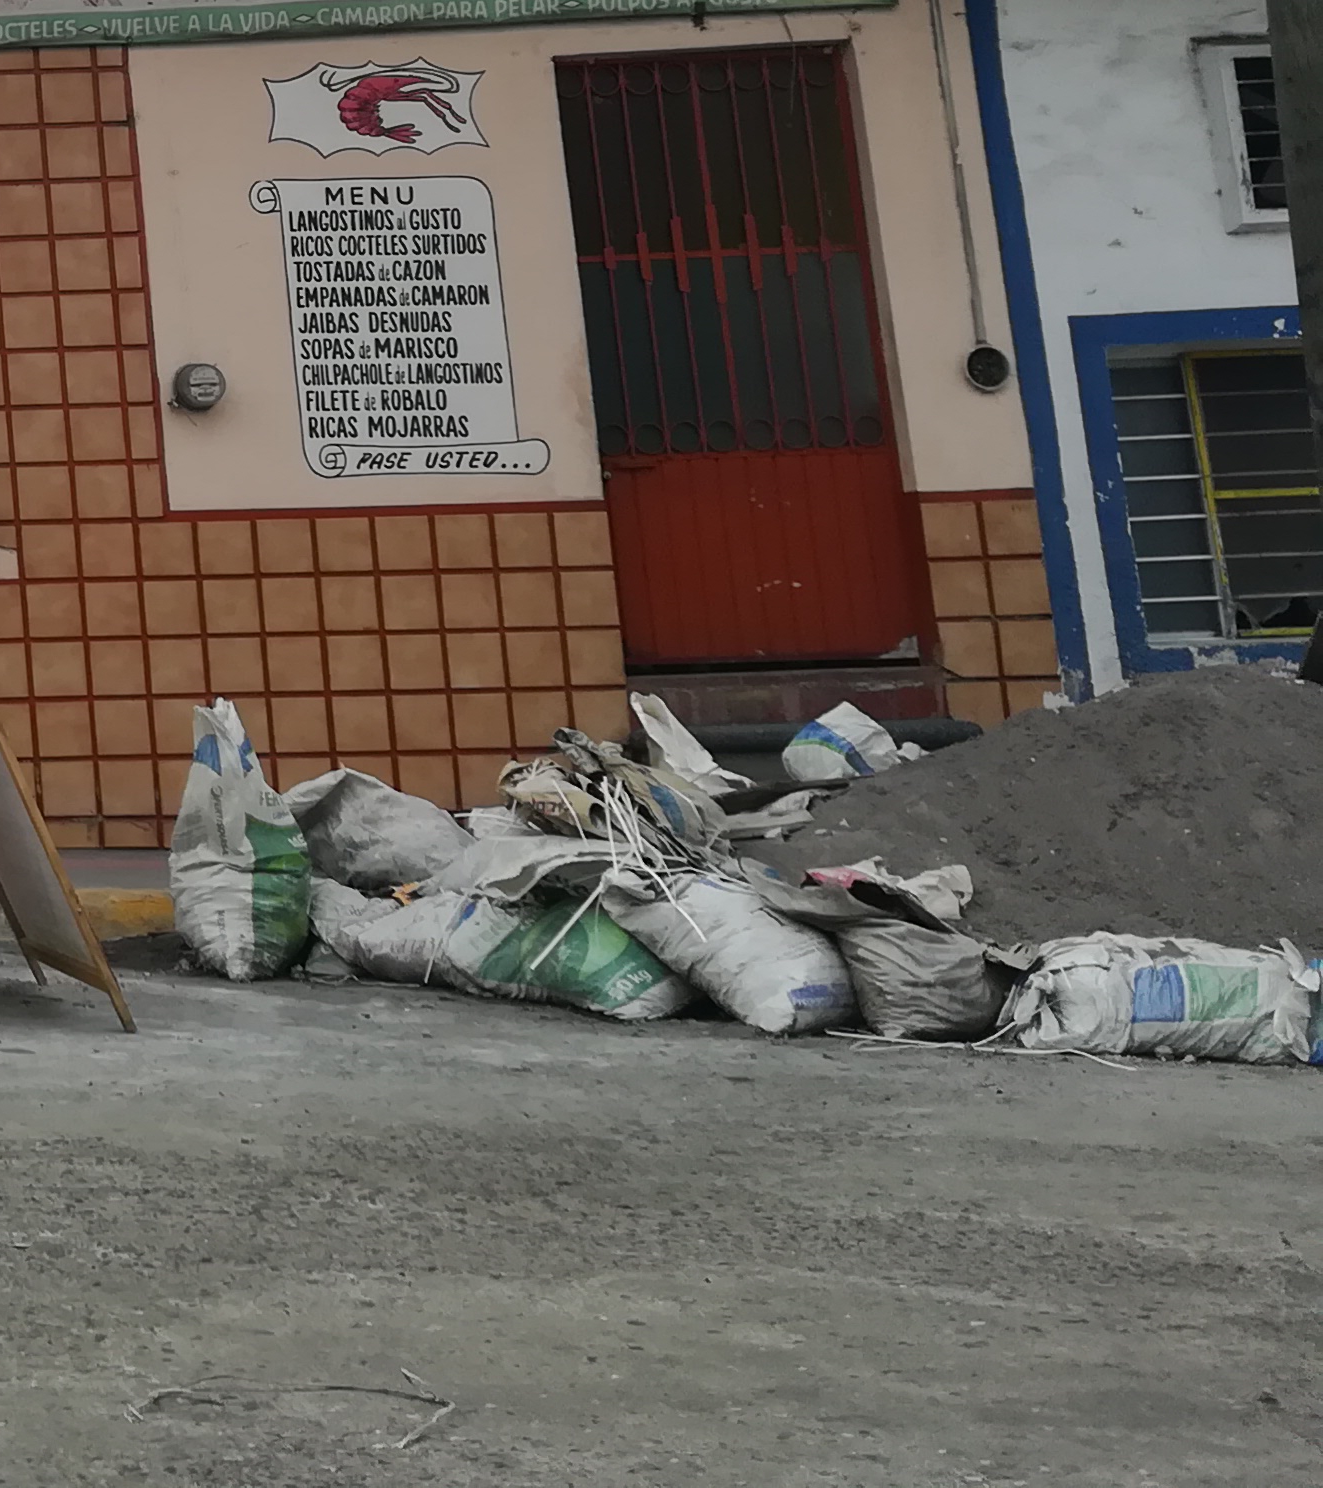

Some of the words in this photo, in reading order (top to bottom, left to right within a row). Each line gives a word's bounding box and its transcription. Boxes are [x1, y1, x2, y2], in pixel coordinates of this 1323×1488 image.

[102, 15, 181, 39] VUELVE
[186, 14, 203, 34] A
[207, 12, 233, 33] LA
[238, 9, 291, 32] VIDA
[316, 3, 426, 28] CAMARON
[325, 185, 415, 206] MENU
[288, 209, 393, 233] LANGOSTINOS
[408, 207, 462, 232] GUSTO
[290, 234, 334, 258] RICOS
[338, 233, 409, 257] COCTELES
[411, 232, 488, 256] SURTIDOS
[293, 260, 375, 283] TOSTADAS
[377, 263, 391, 282] de
[391, 259, 447, 282] CAZON
[295, 285, 398, 309] EMPANADAS
[411, 284, 491, 307] CAMARON
[298, 311, 360, 335] JAIBAS
[368, 310, 453, 334] DESNUDAS
[300, 337, 355, 361] SOPAS
[358, 340, 372, 360] de
[374, 336, 458, 360] MARISCO
[302, 363, 393, 387] CHILPACHOLE
[407, 362, 504, 385] LANGOSTINOS
[305, 389, 360, 412] FILETE
[363, 392, 377, 412] de
[381, 388, 447, 412] ROBALO
[308, 415, 359, 439] RICAS
[367, 414, 470, 439] MOJARRAS
[356, 451, 412, 471] PASE
